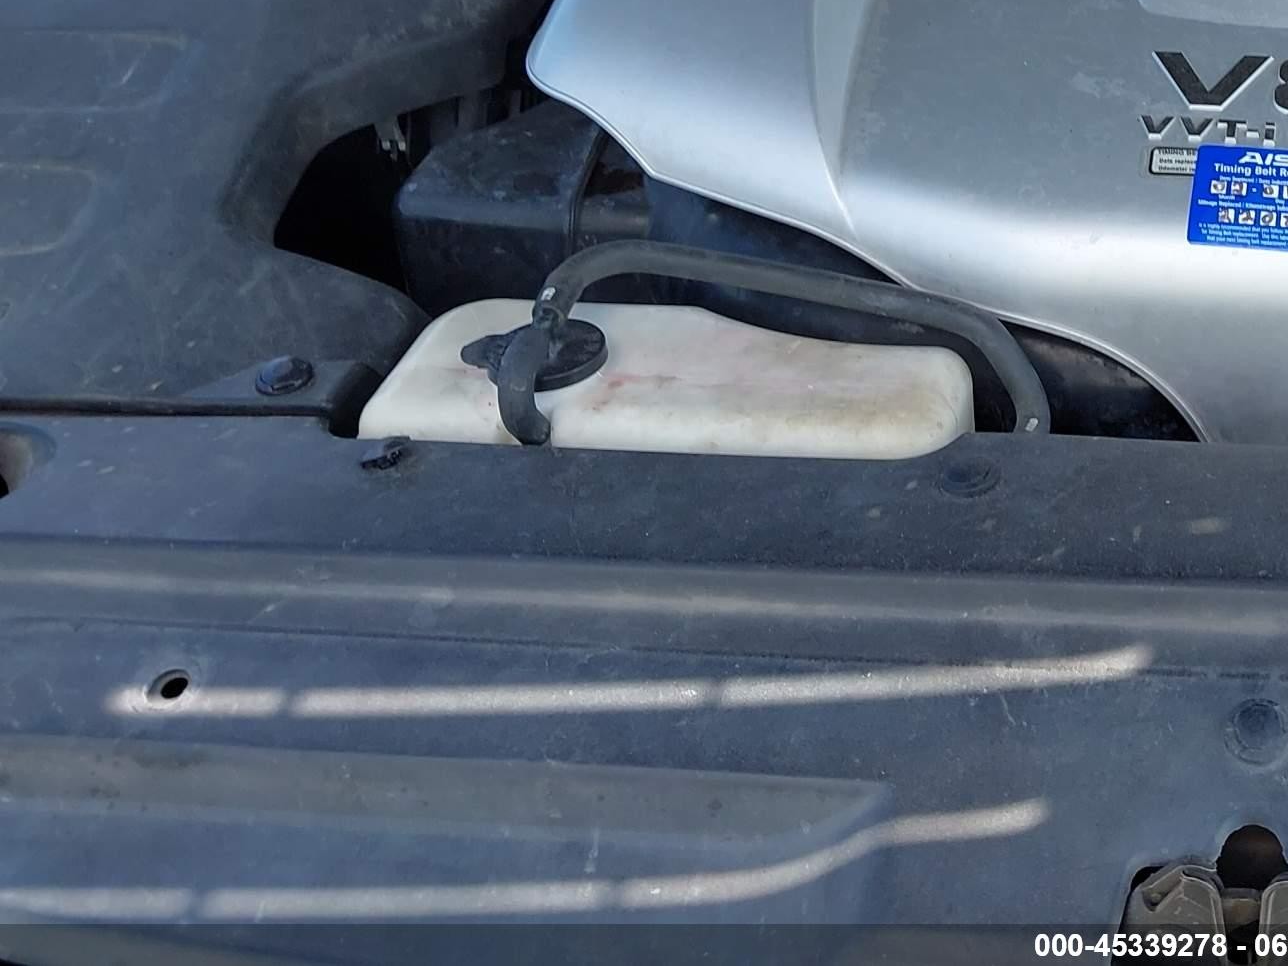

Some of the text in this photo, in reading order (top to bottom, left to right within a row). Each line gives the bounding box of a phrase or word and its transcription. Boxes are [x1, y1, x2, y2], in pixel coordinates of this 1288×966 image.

[1139, 114, 1276, 146] VVT-i
[1214, 163, 1252, 176] Timing
[1255, 164, 1277, 176] Belt
